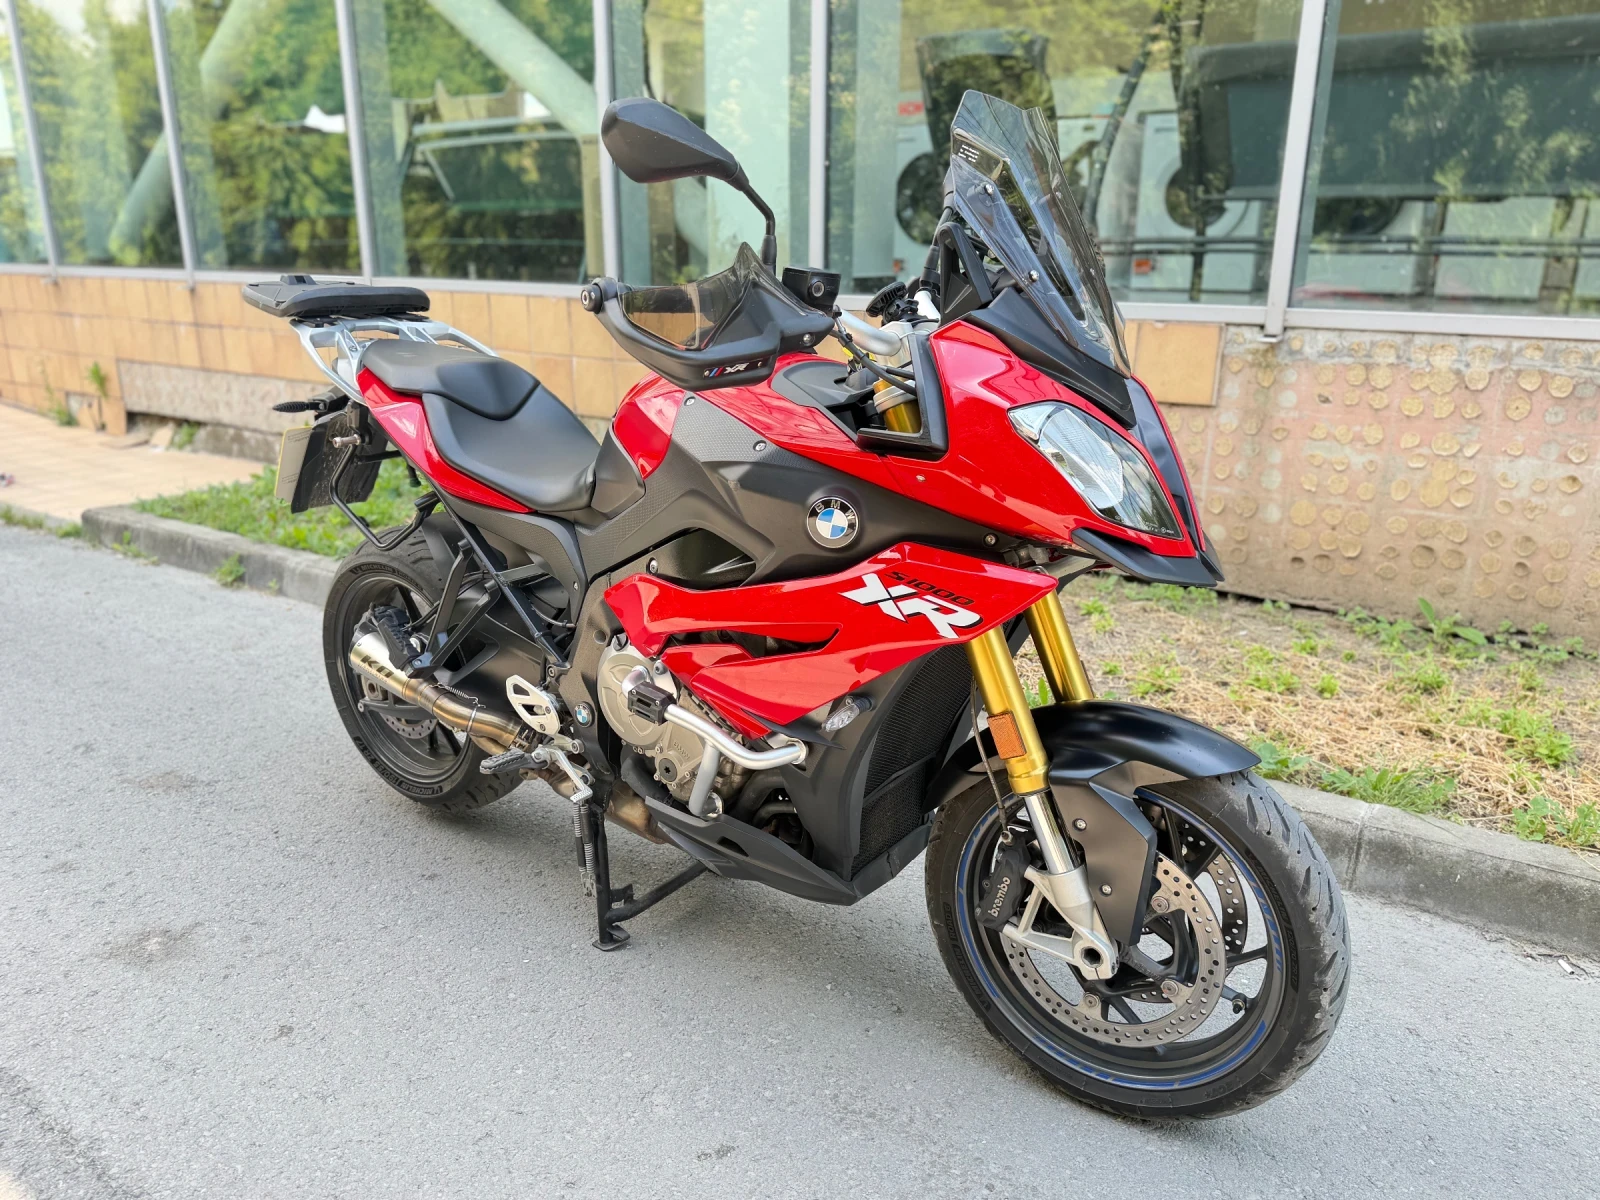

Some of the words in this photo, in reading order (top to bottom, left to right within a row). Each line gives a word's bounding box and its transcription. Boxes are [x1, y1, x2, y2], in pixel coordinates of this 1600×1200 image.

[815, 499, 857, 520] BMW
[837, 572, 984, 640] XR
[988, 876, 1011, 918] brembo
